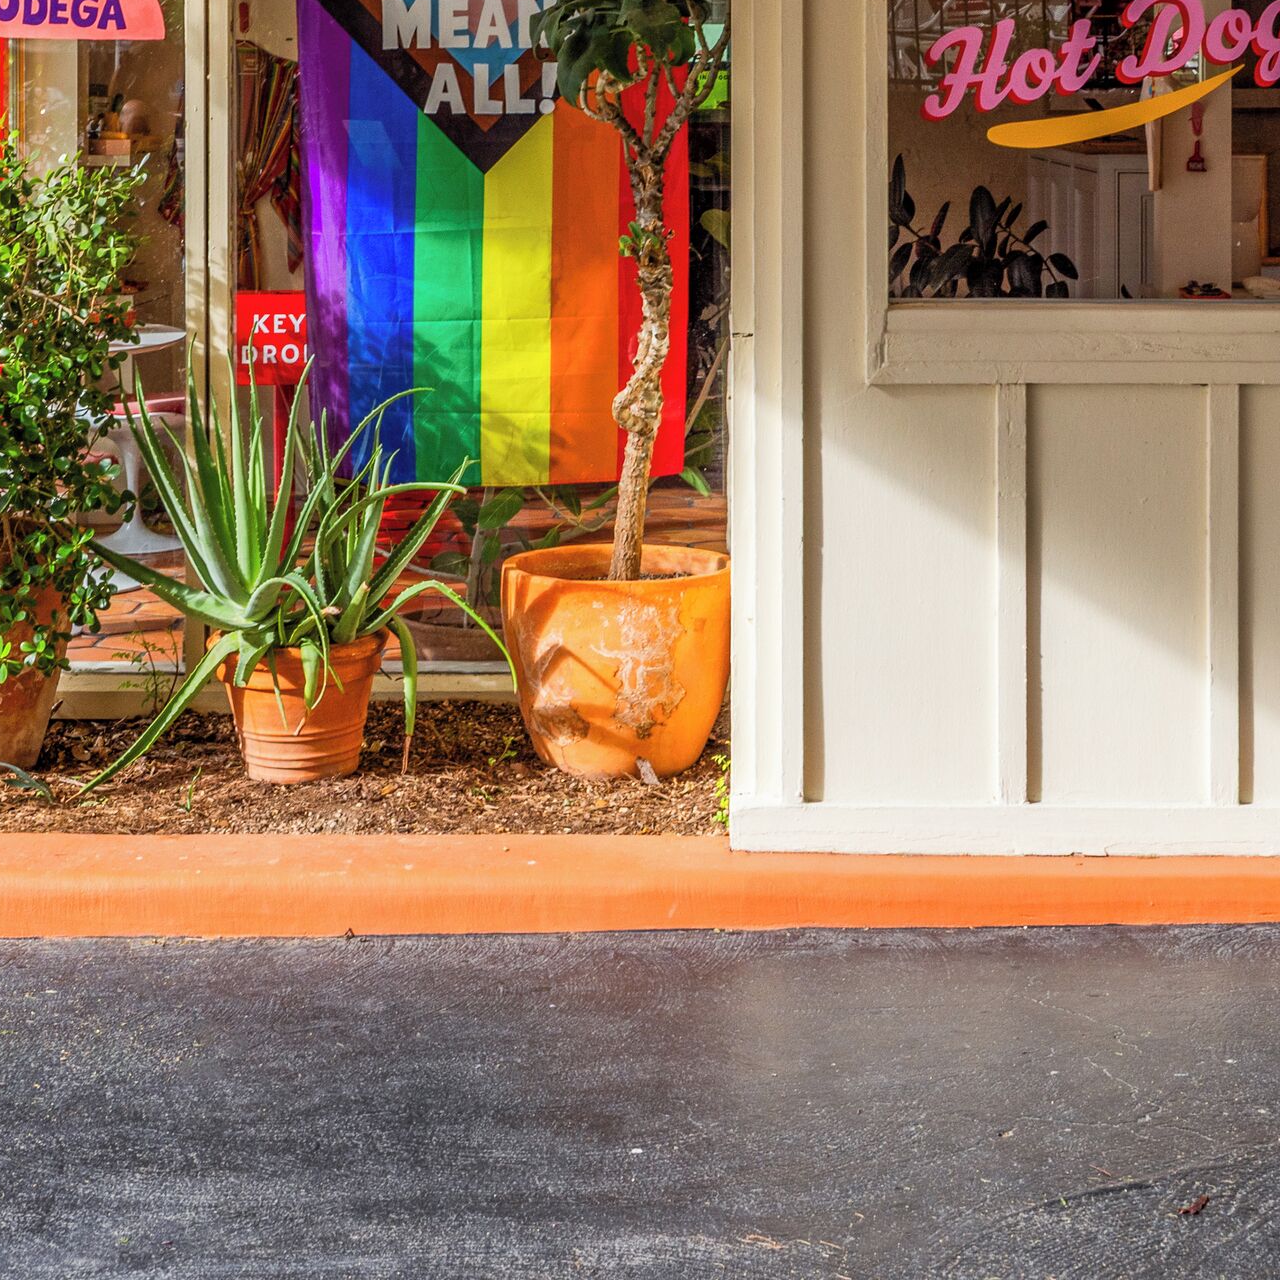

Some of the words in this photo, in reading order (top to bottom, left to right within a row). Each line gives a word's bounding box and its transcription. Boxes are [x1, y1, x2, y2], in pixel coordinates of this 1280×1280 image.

[423, 62, 559, 115] ALL!
[920, 18, 1104, 119] Hot
[253, 313, 307, 334] KEY
